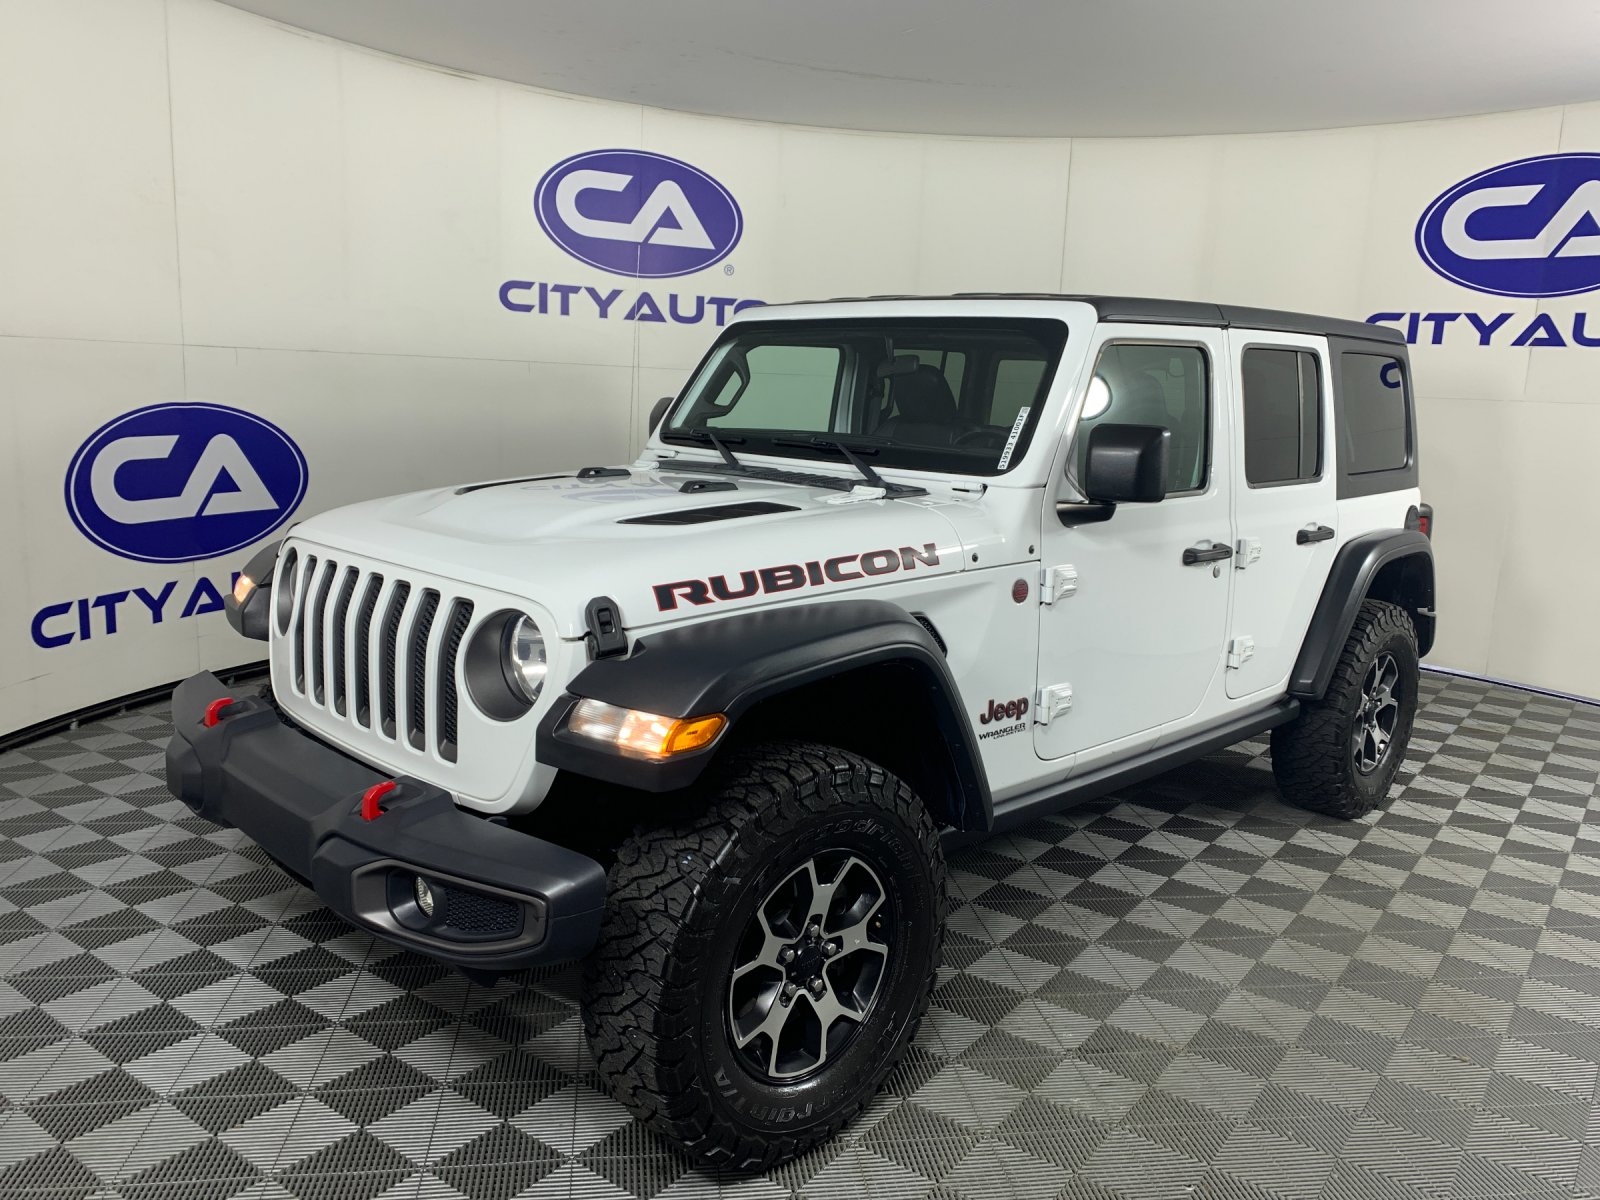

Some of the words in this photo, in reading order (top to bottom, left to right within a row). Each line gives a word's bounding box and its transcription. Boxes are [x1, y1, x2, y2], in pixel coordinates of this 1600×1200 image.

[555, 169, 716, 250] CA
[1441, 180, 1600, 260] CA
[90, 433, 280, 525] CA
[31, 571, 241, 649] CITYA
[652, 542, 940, 612] RUBICON
[979, 722, 1026, 740] WRANGLER
[980, 697, 1029, 725] Jeep
